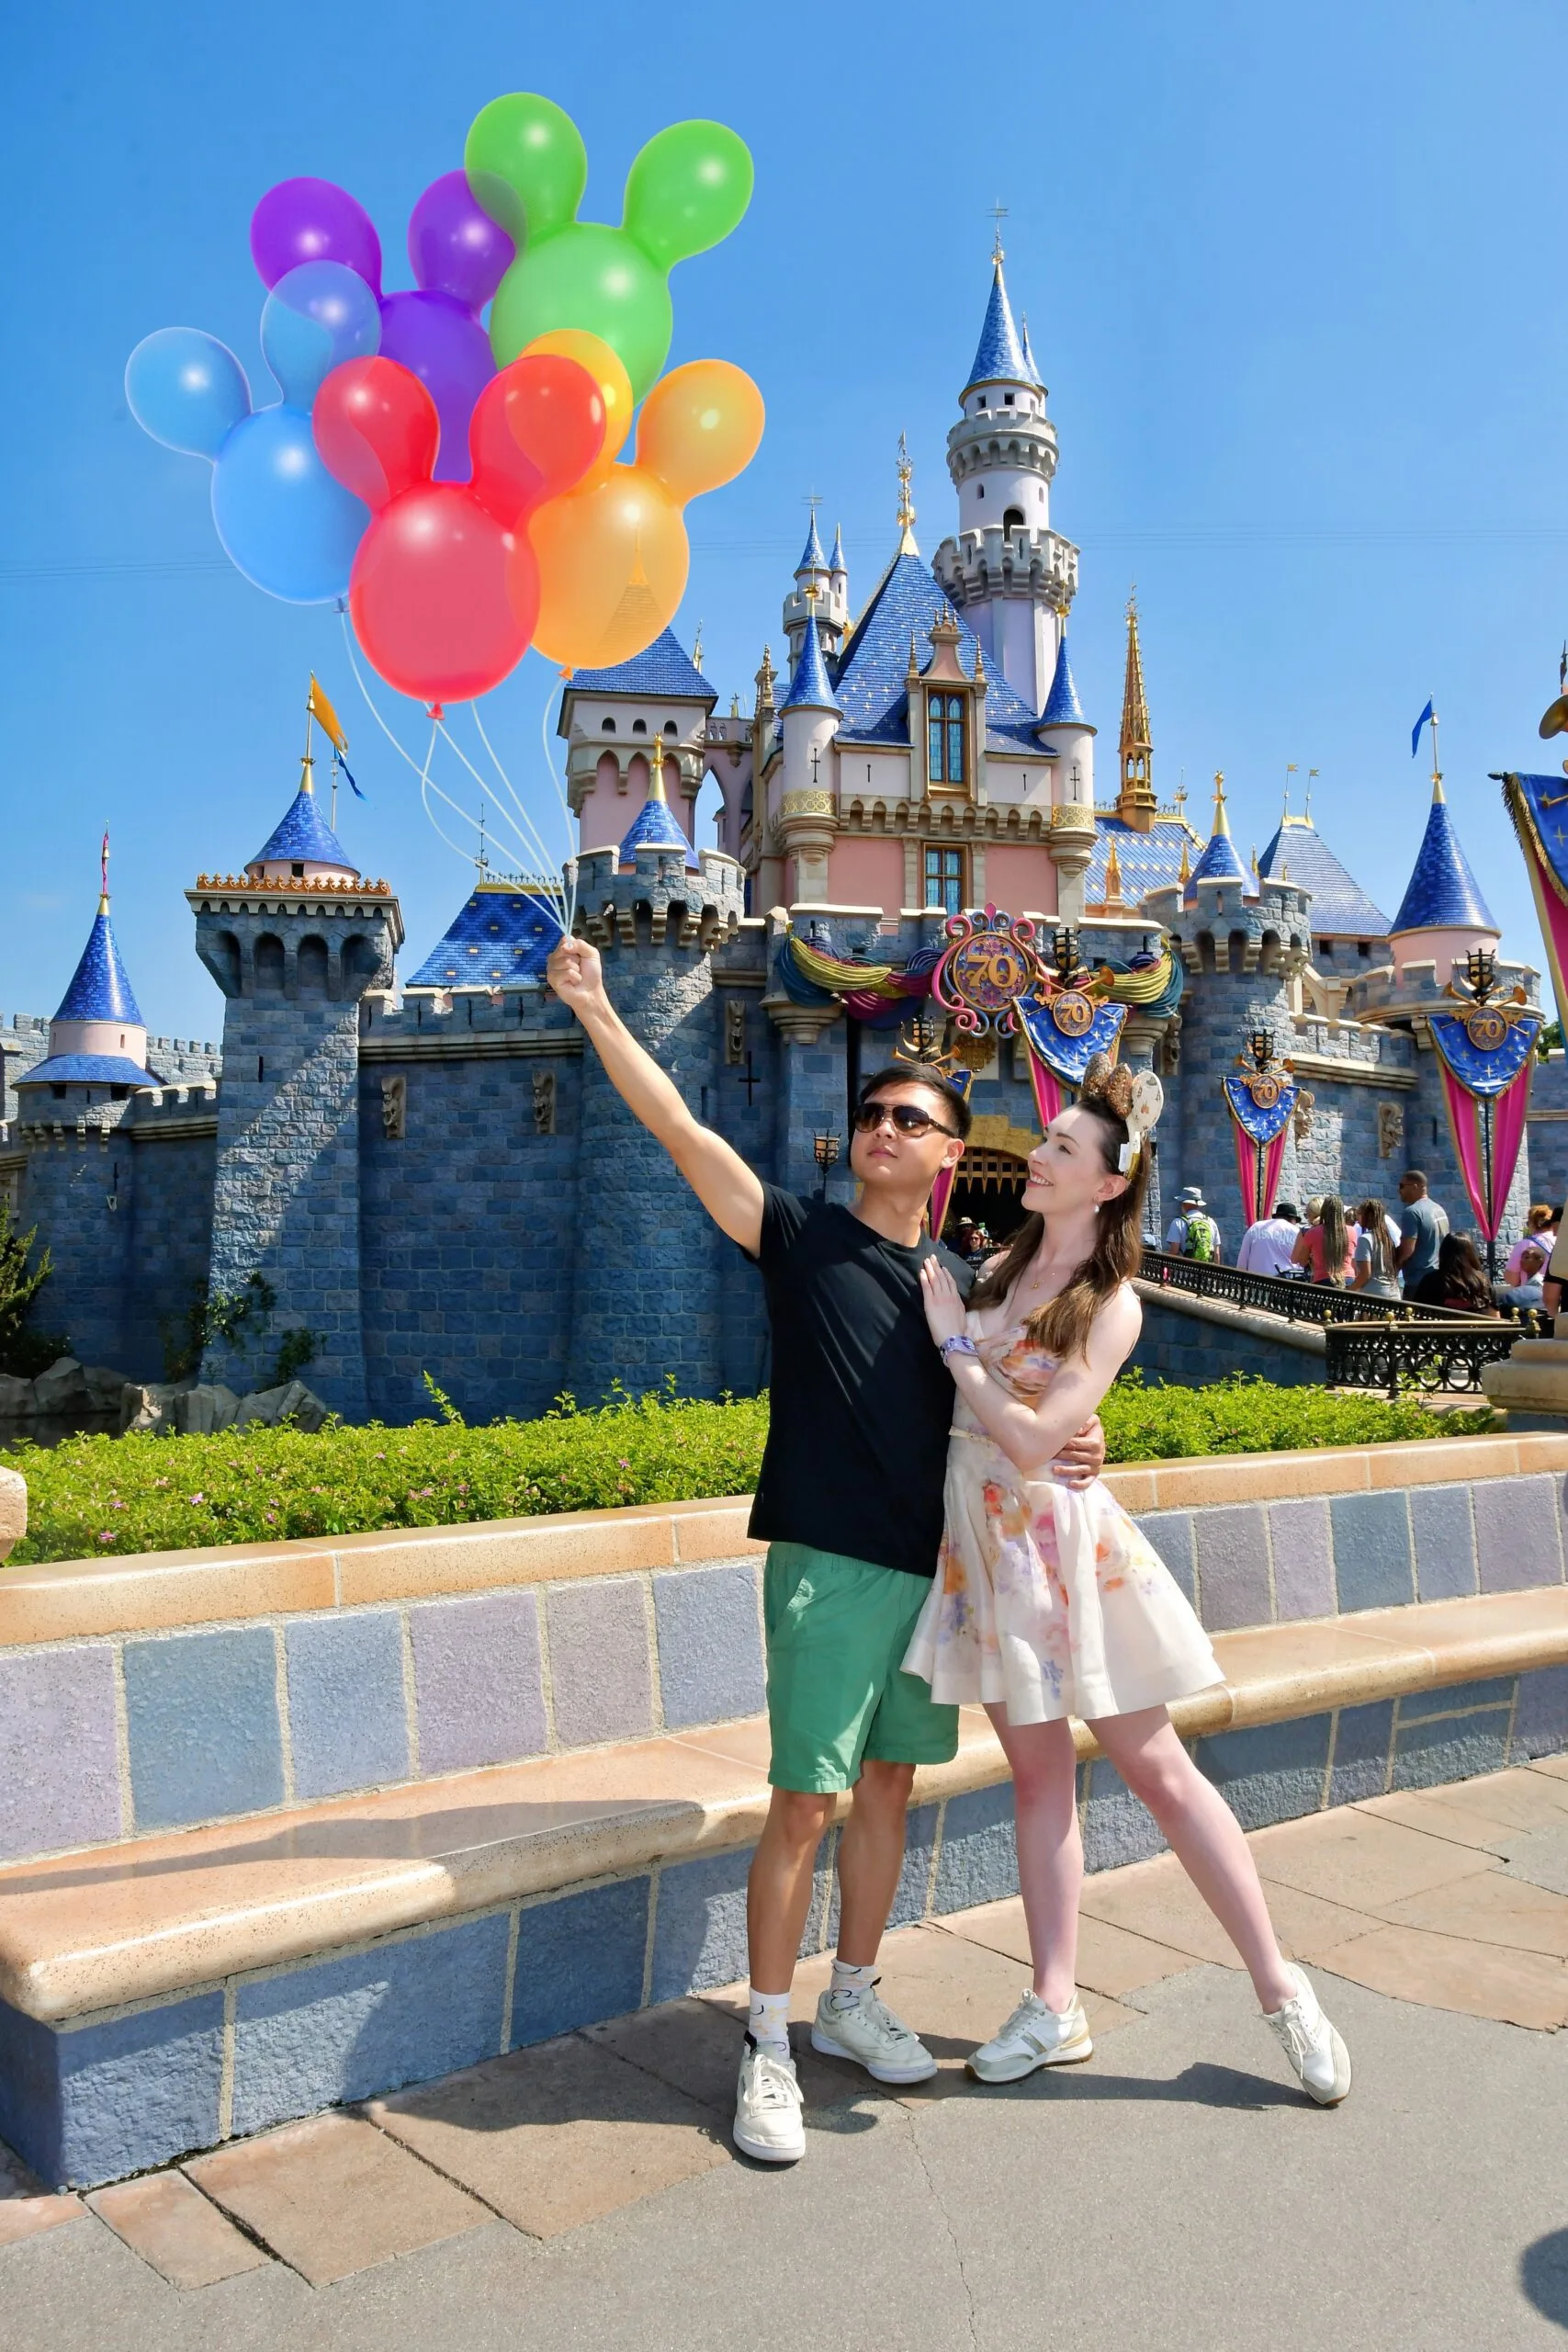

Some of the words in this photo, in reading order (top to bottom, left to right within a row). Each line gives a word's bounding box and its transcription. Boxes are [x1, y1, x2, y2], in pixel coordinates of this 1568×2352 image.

[966, 955, 1019, 988] 70
[1060, 1003, 1088, 1023] 70
[1474, 1019, 1502, 1038] 70
